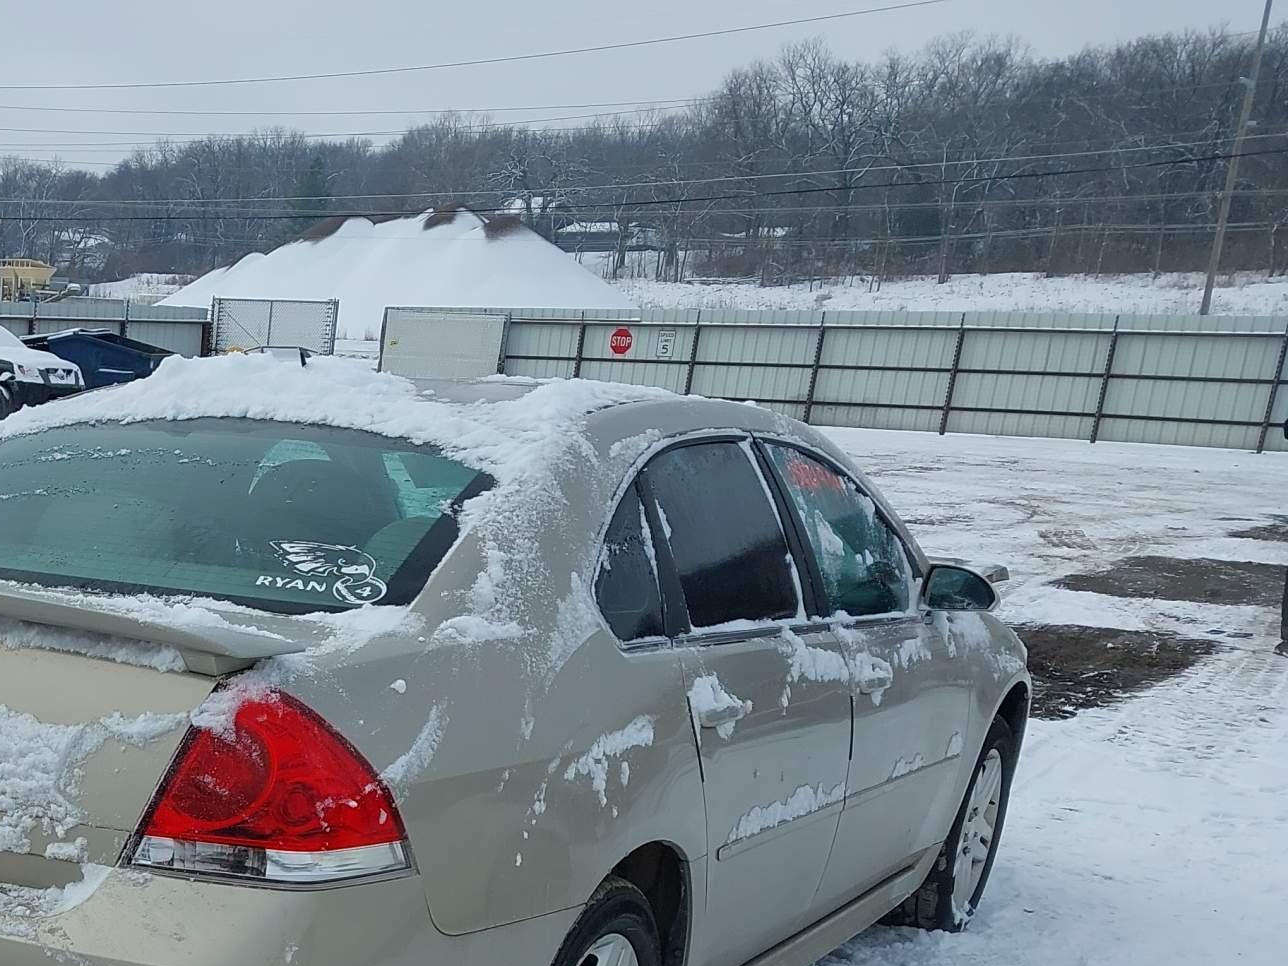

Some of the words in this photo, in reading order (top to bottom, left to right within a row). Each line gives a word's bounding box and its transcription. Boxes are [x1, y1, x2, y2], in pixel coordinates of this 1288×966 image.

[612, 336, 632, 347] STOP
[661, 344, 669, 354] 5
[255, 575, 327, 593] RYAN
[354, 586, 372, 597] 4
